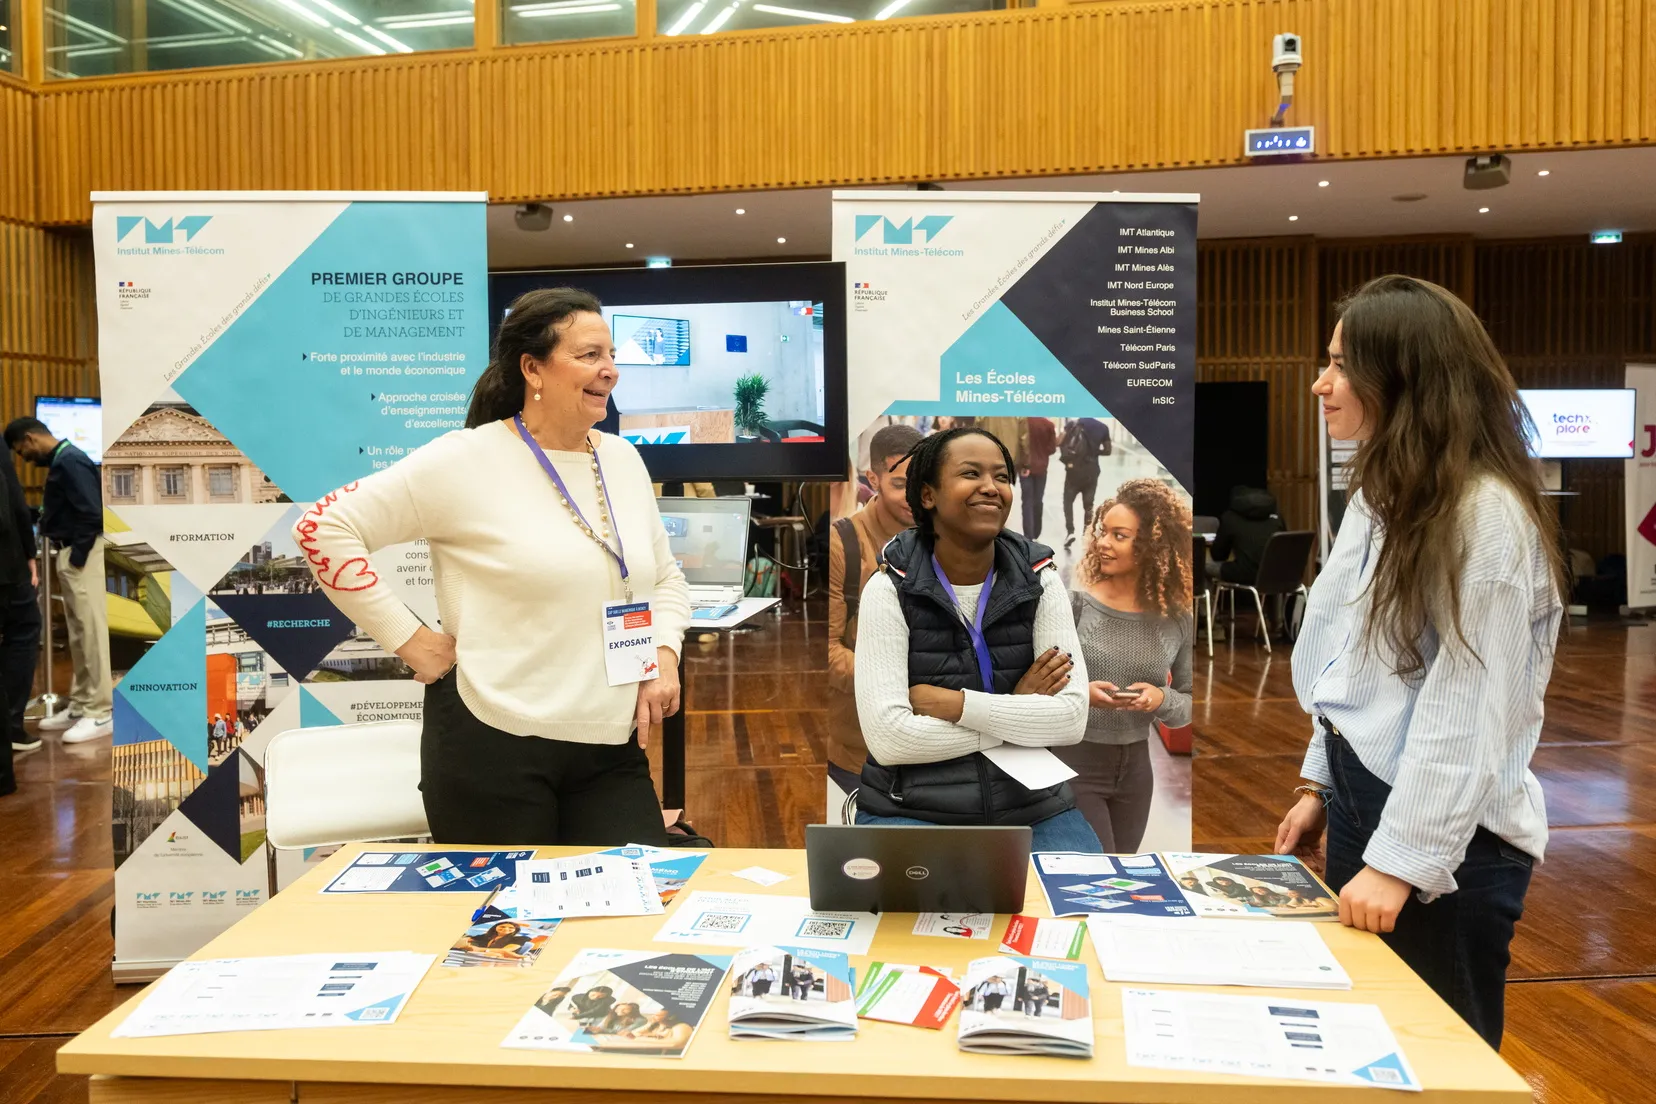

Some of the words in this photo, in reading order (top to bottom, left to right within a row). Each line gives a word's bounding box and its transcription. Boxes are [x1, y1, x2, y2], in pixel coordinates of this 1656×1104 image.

[1136, 229, 1174, 238] Atlantique
[118, 247, 150, 255] Institut
[153, 246, 224, 255] Mines-Télécom
[854, 247, 888, 256] Institut
[891, 247, 964, 256] Mines-Télécom
[962, 308, 974, 321] Les
[973, 285, 998, 310] Grandes
[997, 266, 1018, 286] Écoles
[1017, 256, 1028, 268] des
[1028, 238, 1048, 259] grands
[1048, 224, 1063, 238] défis
[311, 272, 387, 285] PREMIER
[392, 272, 464, 285] GROUPE
[1146, 282, 1174, 290] Europe
[324, 292, 341, 303] DE
[345, 292, 410, 303] GRANDES
[413, 290, 464, 303] ÉCOLES
[350, 308, 444, 320] D'INGÉNIEURS
[448, 309, 464, 320] ET
[164, 368, 177, 382] Les
[174, 344, 202, 370] Grandes
[200, 324, 222, 345] Écoles
[221, 313, 234, 325] des
[233, 293, 254, 315] grands
[253, 277, 269, 294] défis
[344, 326, 362, 338] DE
[366, 326, 465, 338] MANAGEMENT
[1123, 324, 1176, 334] Saint-Étienne
[311, 352, 337, 362] Forte
[340, 352, 387, 364] proximité
[418, 352, 465, 361] l'industrie
[340, 367, 350, 375] et
[353, 366, 362, 375] le
[366, 366, 401, 375] monde
[404, 366, 466, 376] économique
[956, 372, 982, 384] Les
[987, 369, 1035, 384] Écoles
[378, 392, 427, 403] Approche
[430, 392, 466, 401] croisée
[956, 390, 1065, 403] Mines-Télécom
[381, 406, 467, 417] d'enseignements
[367, 447, 382, 455] Un
[385, 446, 404, 455] rôle
[373, 460, 387, 468] les
[169, 534, 234, 542] #FORMATION
[397, 564, 426, 572] avenir
[267, 619, 330, 628] #RECHERCHE
[609, 636, 652, 650] EXPOSANT
[130, 683, 197, 692] #INNOVATION
[357, 712, 422, 721] ÉCONOMIQUE
